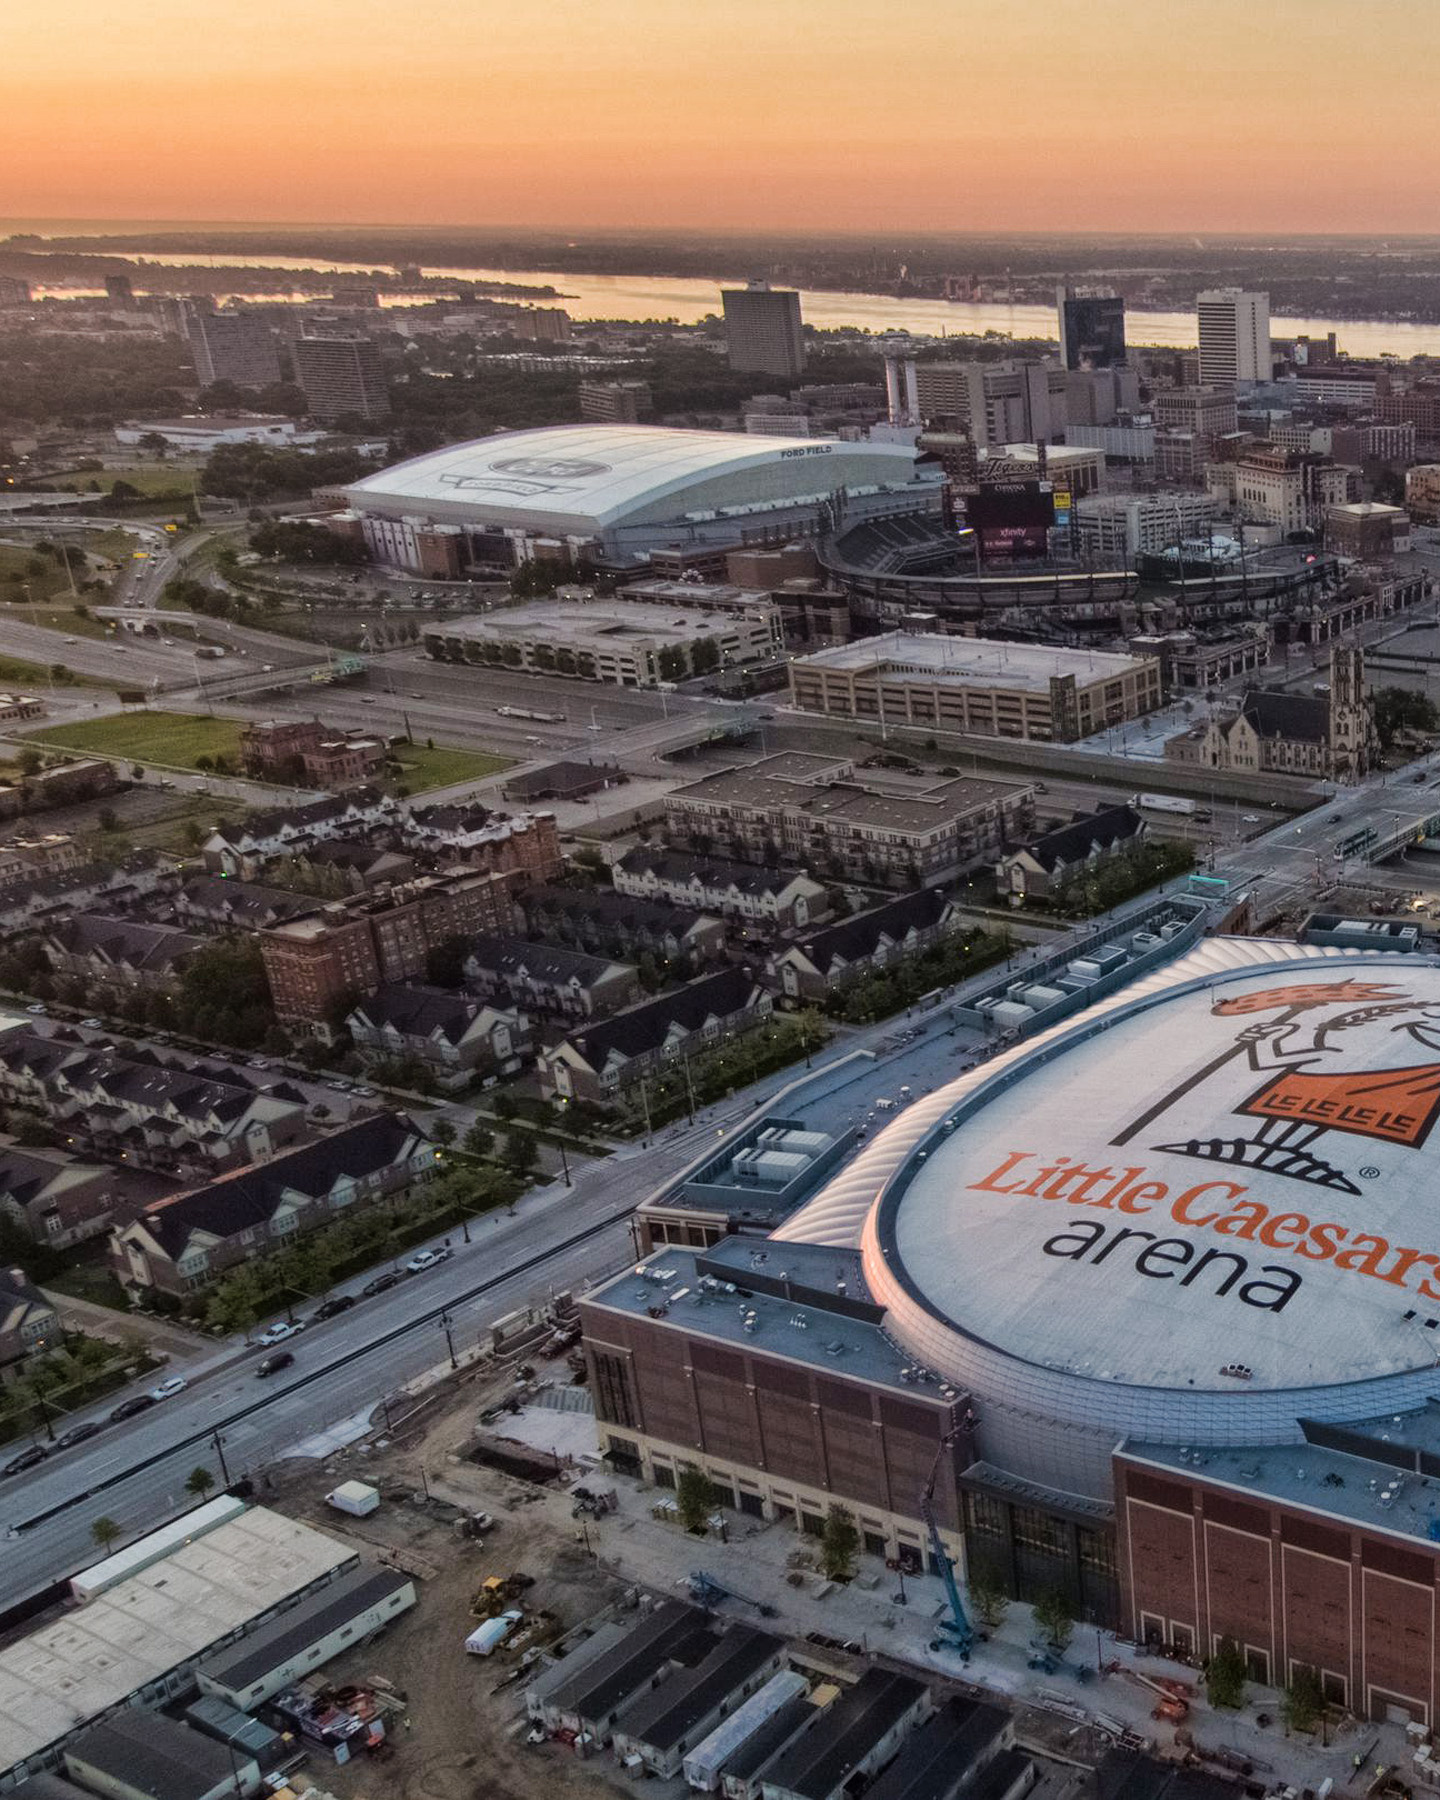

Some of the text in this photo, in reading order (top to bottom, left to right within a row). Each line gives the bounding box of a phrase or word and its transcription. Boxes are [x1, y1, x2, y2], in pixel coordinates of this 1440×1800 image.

[781, 445, 832, 458] FORD FIELD
[983, 456, 1035, 480] Tigers
[1000, 527, 1026, 537] xfinity
[965, 1152, 1169, 1214] Little
[1043, 1220, 1303, 1313] arena
